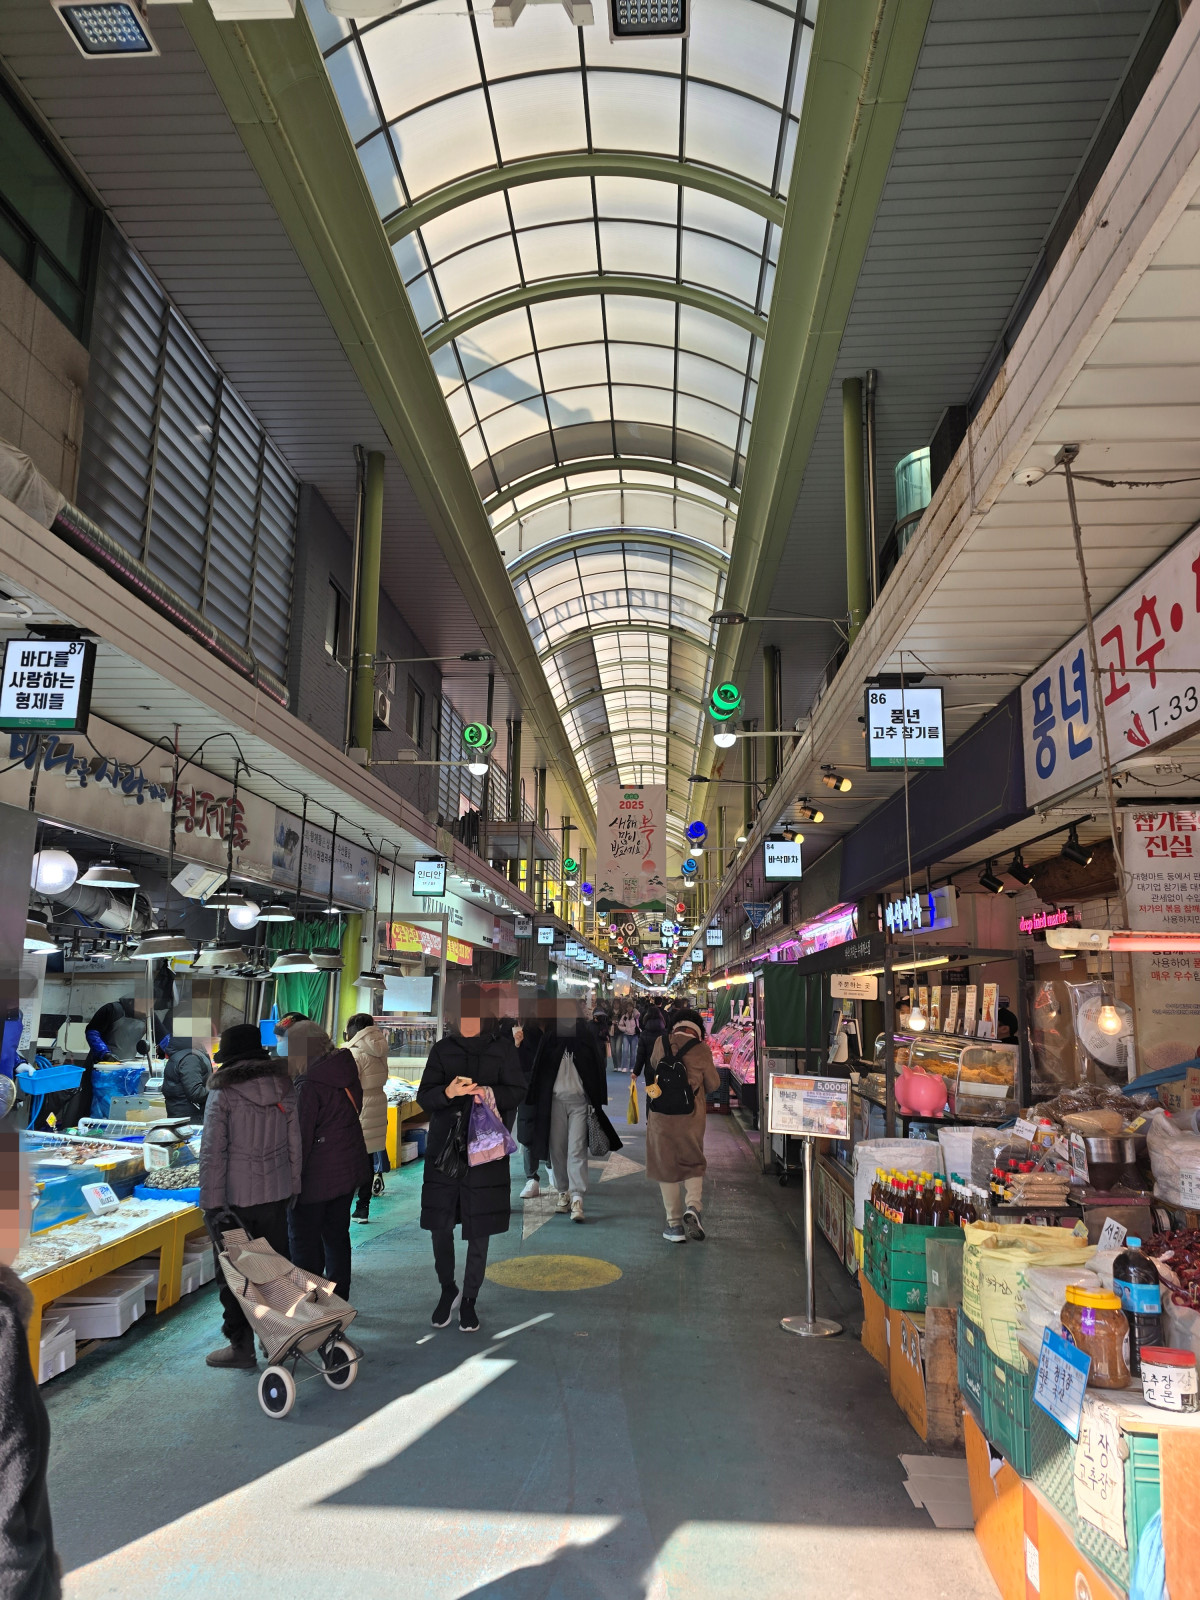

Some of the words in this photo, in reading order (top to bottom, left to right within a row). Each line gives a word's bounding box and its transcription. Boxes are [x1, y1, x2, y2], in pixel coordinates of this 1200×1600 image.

[69, 642, 85, 655] 87
[20, 651, 70, 668] 바다를
[8, 671, 76, 689] 사랑하는
[15, 691, 65, 710] 형제들
[870, 693, 887, 705] 86
[891, 709, 920, 724] 풍년
[1032, 648, 1093, 780] 풍년
[872, 726, 898, 739] 고추
[901, 726, 940, 739] 참기름
[619, 800, 645, 810] 2025
[608, 814, 638, 830] 새해
[1134, 812, 1200, 832] 참기름
[638, 808, 658, 860] 복
[610, 839, 641, 858] 받으세요
[1144, 834, 1194, 858] 진실
[768, 855, 799, 864] 바삭마차
[417, 870, 442, 880] 인디안
[1132, 872, 1165, 882] 대형마트
[1166, 872, 1191, 882] 등에서
[1137, 883, 1162, 892] 대기업
[1163, 883, 1188, 892] 참기름
[1151, 893, 1184, 903] 관세없이
[1139, 904, 1163, 914] 저가의
[1151, 958, 1190, 969] 사용하여
[1151, 971, 1171, 982] 매우
[817, 1082, 848, 1092] 5,000원
[1141, 1371, 1174, 1390] 고추장
